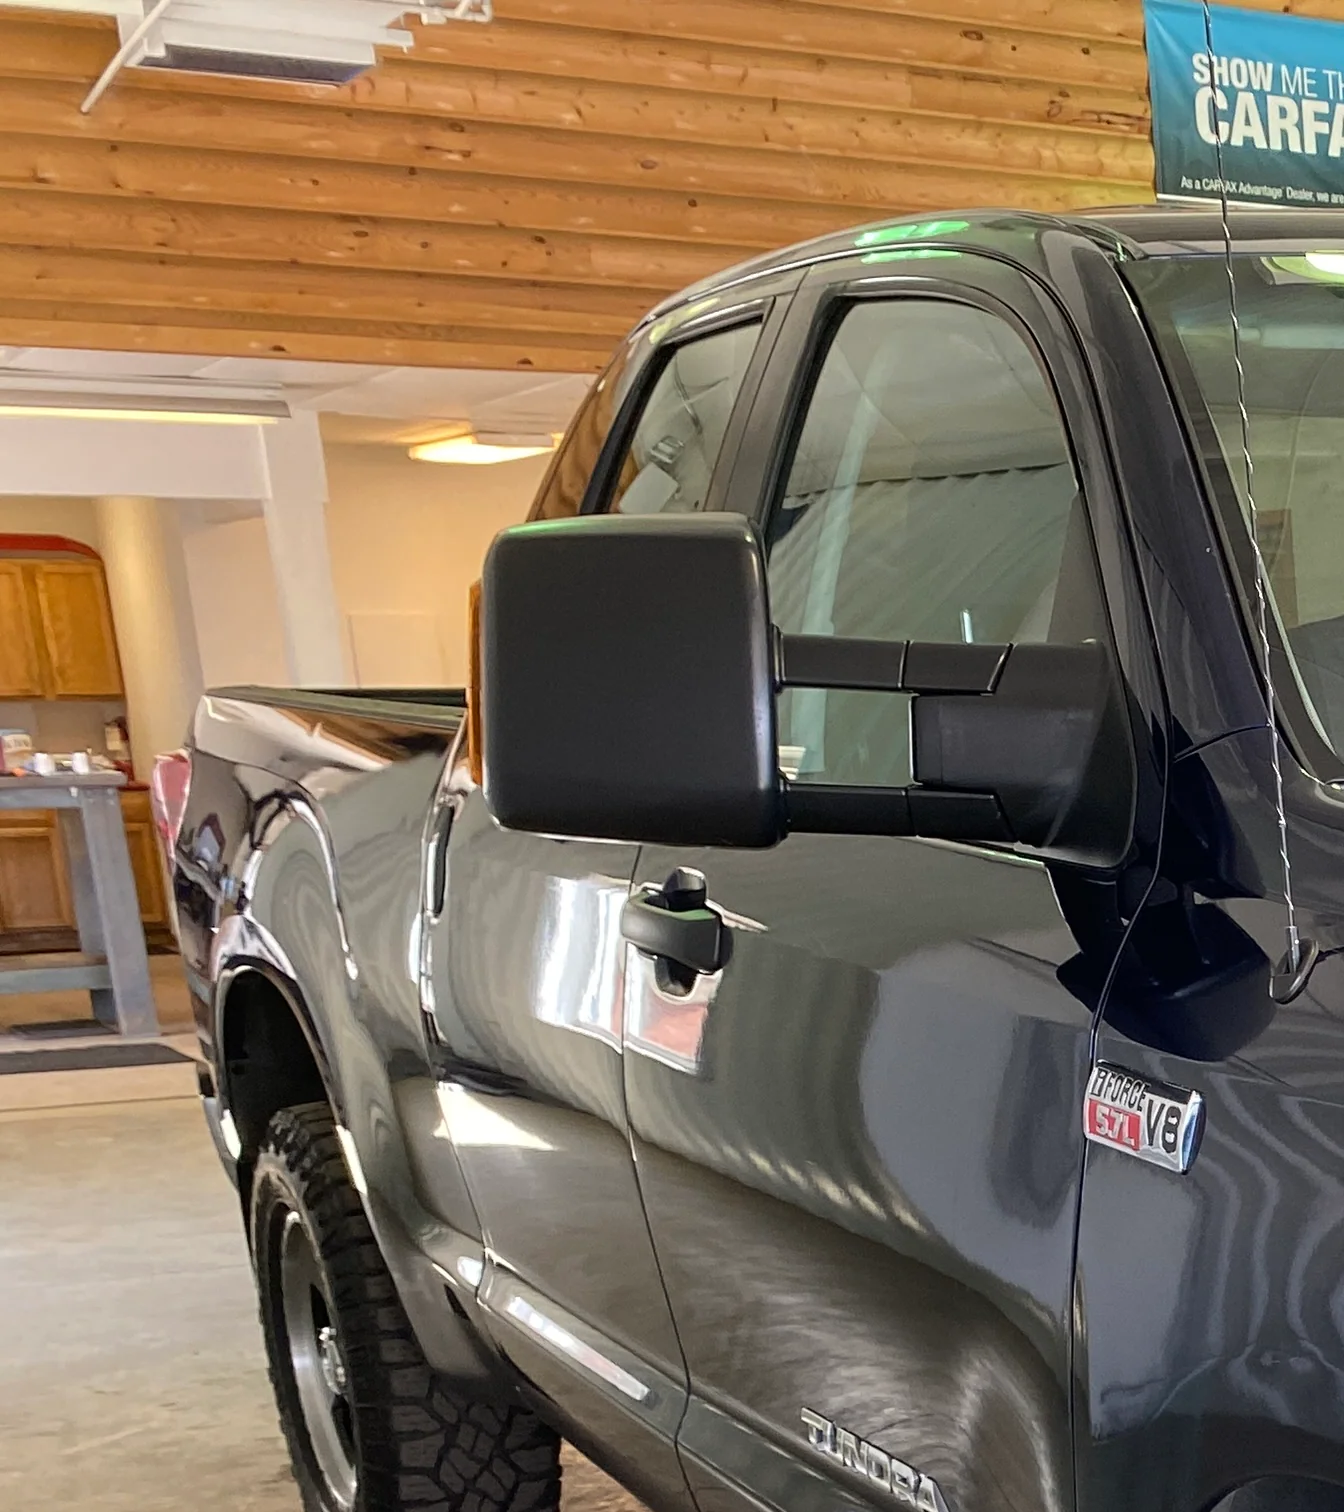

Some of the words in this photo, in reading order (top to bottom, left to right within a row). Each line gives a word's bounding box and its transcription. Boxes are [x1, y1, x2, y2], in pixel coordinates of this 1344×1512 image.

[1192, 53, 1273, 92] SHOW
[1281, 67, 1318, 98] ME
[1181, 175, 1193, 189] As
[1194, 179, 1201, 190] a
[1202, 178, 1237, 194] CARAX
[1316, 191, 1329, 203] we
[1331, 193, 1344, 204] are
[1146, 1098, 1182, 1154] V8
